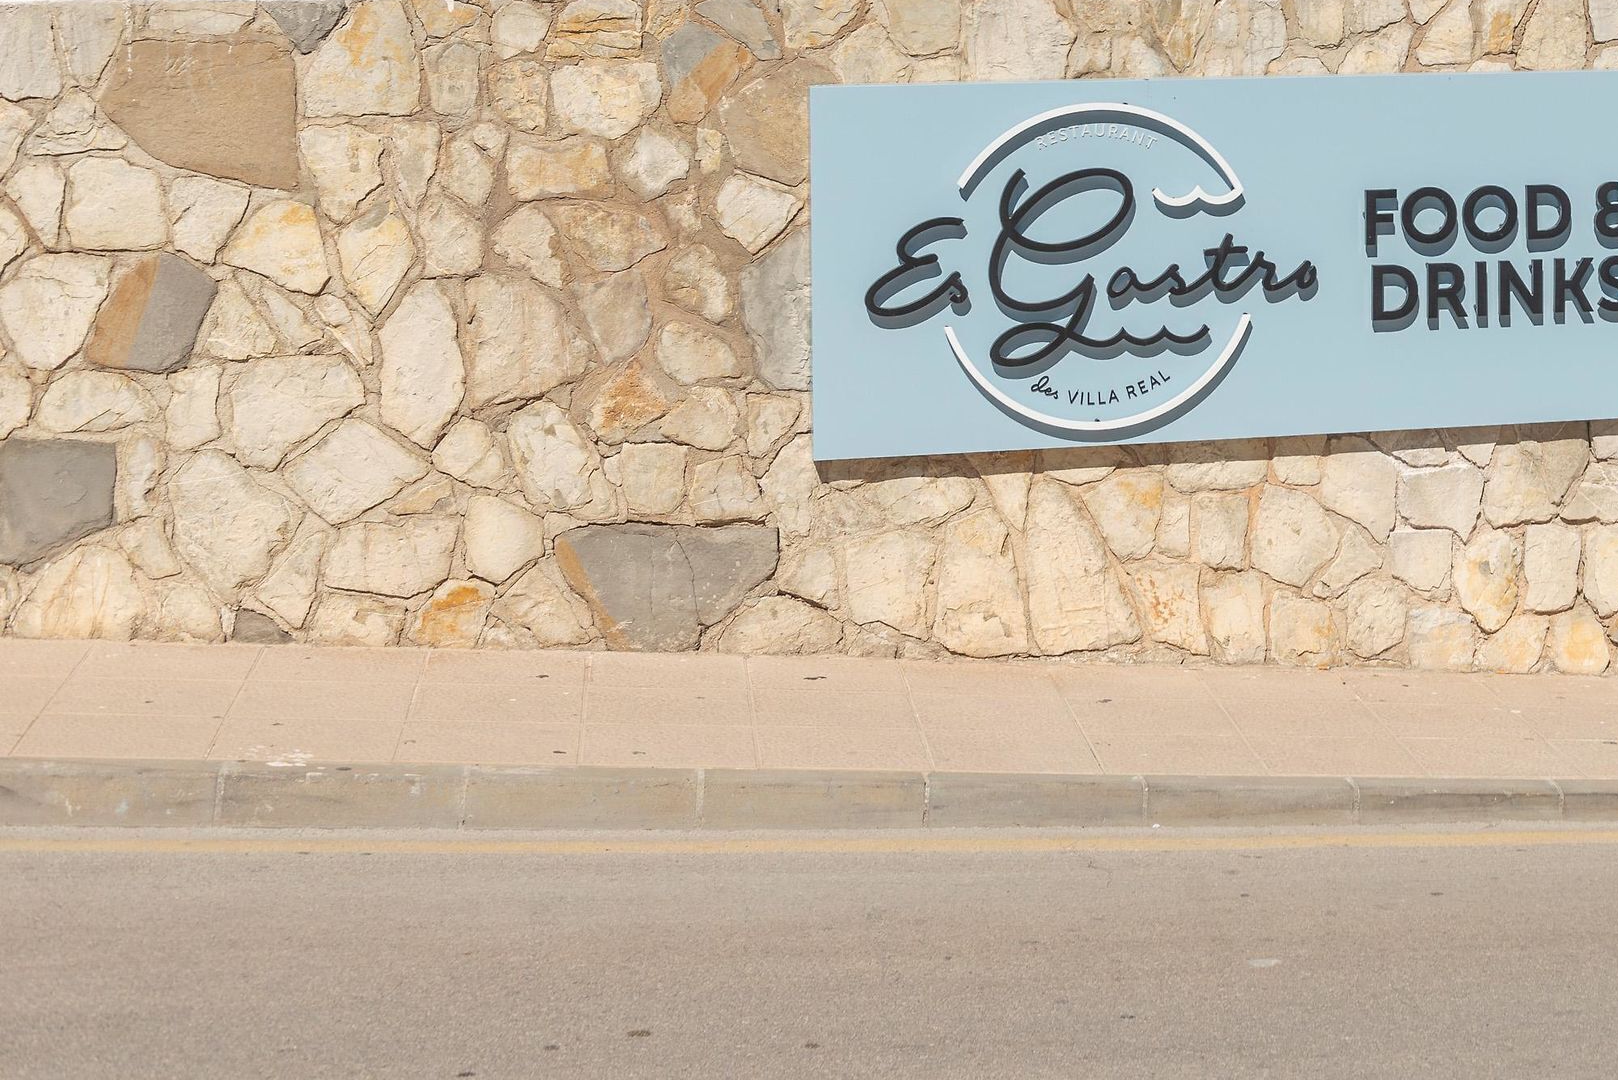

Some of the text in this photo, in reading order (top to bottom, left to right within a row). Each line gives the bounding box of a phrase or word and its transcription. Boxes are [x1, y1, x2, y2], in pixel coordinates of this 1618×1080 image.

[1035, 123, 1158, 150] RESTAURANT
[1364, 184, 1572, 247] FOOD
[865, 167, 1318, 368] Es Gastro
[1031, 370, 1171, 405] des VILLA REAL
